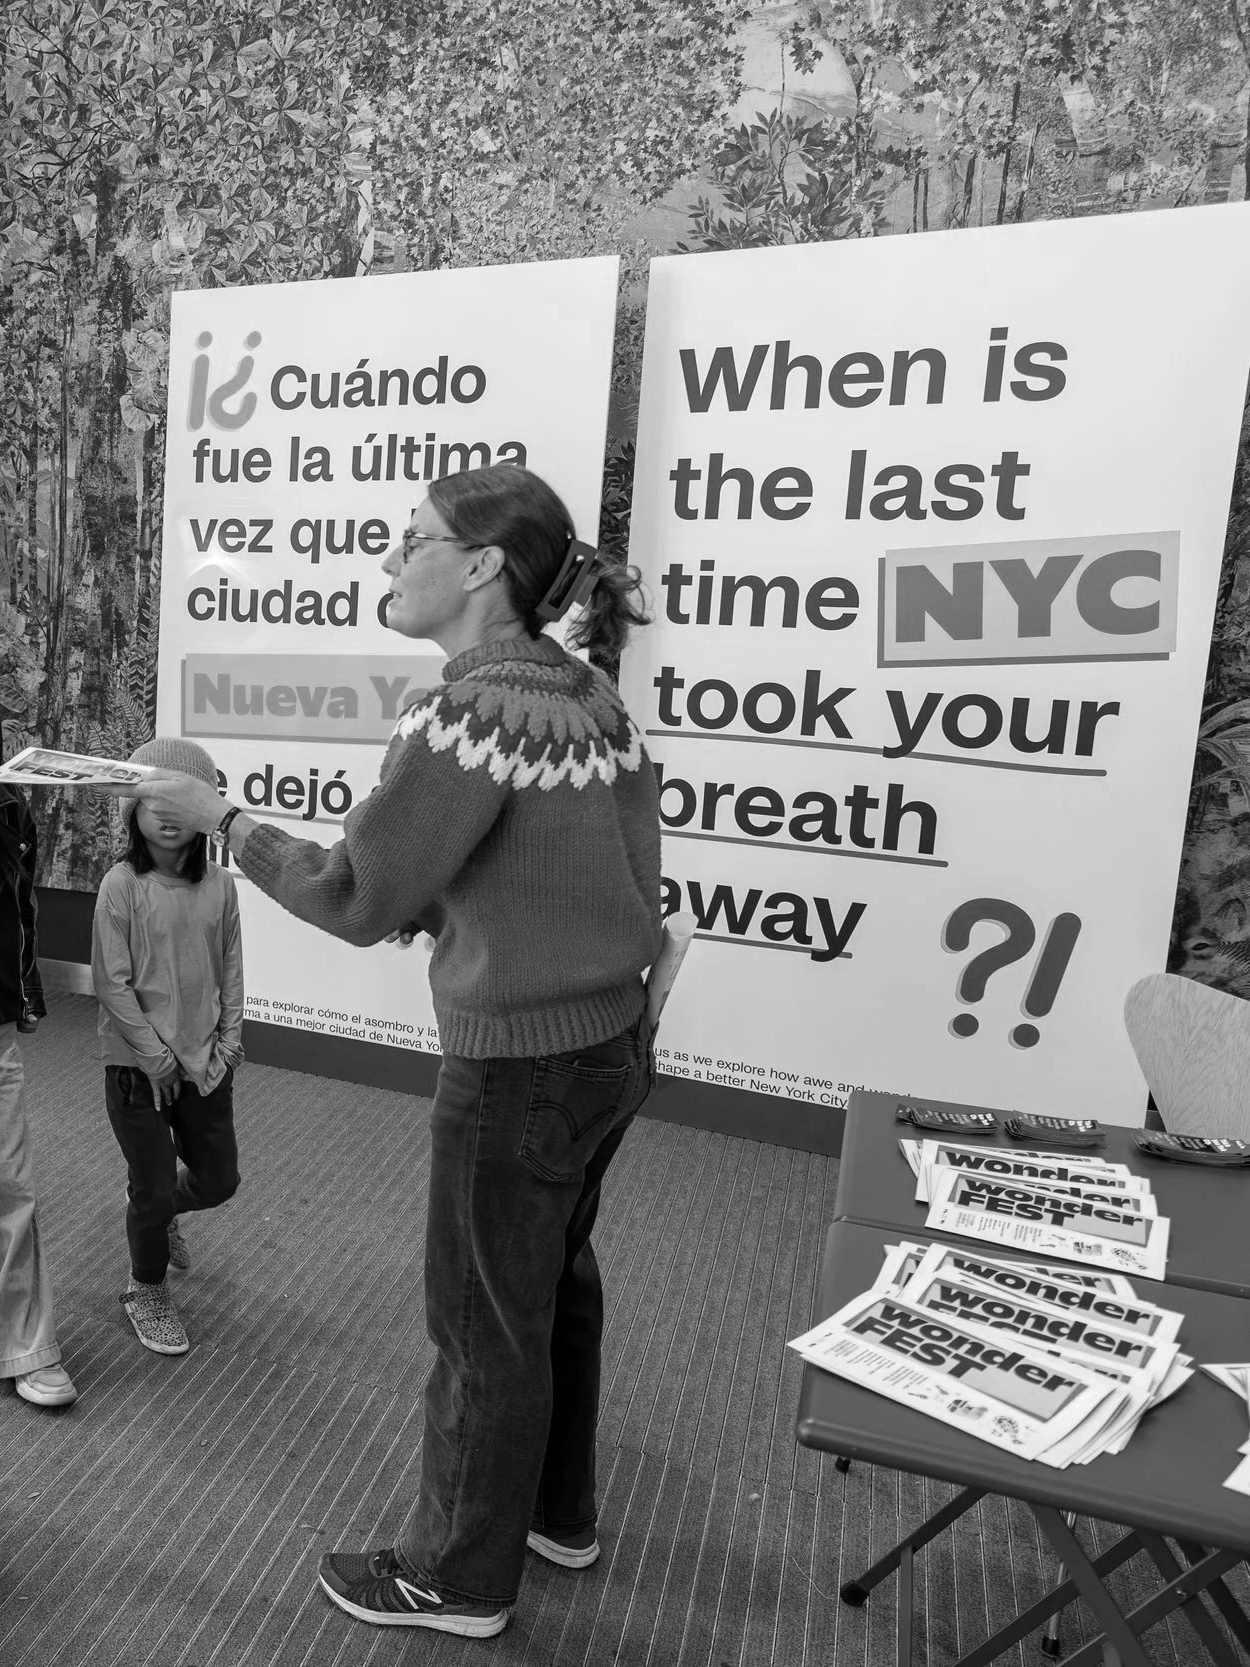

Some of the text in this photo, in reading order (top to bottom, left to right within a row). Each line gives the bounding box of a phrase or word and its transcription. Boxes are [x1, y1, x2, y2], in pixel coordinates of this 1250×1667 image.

[679, 326, 1068, 414] When is
[193, 439, 272, 484] fue
[288, 436, 333, 483] la
[669, 449, 1031, 522] the last
[190, 516, 273, 554] vez
[290, 516, 390, 564] que
[187, 578, 359, 627] ciudad
[662, 549, 1162, 643] time NYC
[193, 672, 358, 720] Nueva
[653, 665, 1120, 758] took your
[15, 761, 94, 781] FEST
[243, 764, 352, 821] dejó
[652, 762, 938, 855] breath
[659, 876, 868, 962] away
[246, 995, 438, 1037] para explorar cómo el asombro y la
[263, 1012, 271, 1020] a
[273, 1013, 293, 1025] una
[296, 1017, 326, 1033] mejor
[329, 1023, 366, 1038] ciudad
[369, 1030, 383, 1041] de
[386, 1033, 422, 1049] Nueva
[654, 1046, 670, 1058] us
[673, 1050, 689, 1062] as
[693, 1054, 713, 1066] we
[716, 1058, 766, 1077] explore
[770, 1067, 800, 1083] how
[803, 1076, 833, 1090] awe
[837, 1082, 865, 1094] and
[693, 1069, 702, 1079] a
[706, 1070, 746, 1087] better
[750, 1079, 781, 1094] New
[785, 1086, 815, 1102] York
[957, 1190, 1075, 1226] FEST
[964, 1179, 1144, 1226] wonder
[953, 1257, 1151, 1325] wonder
[850, 1316, 988, 1379] FEST
[879, 1304, 1077, 1392] wonder
[940, 1285, 1143, 1359] wonder
